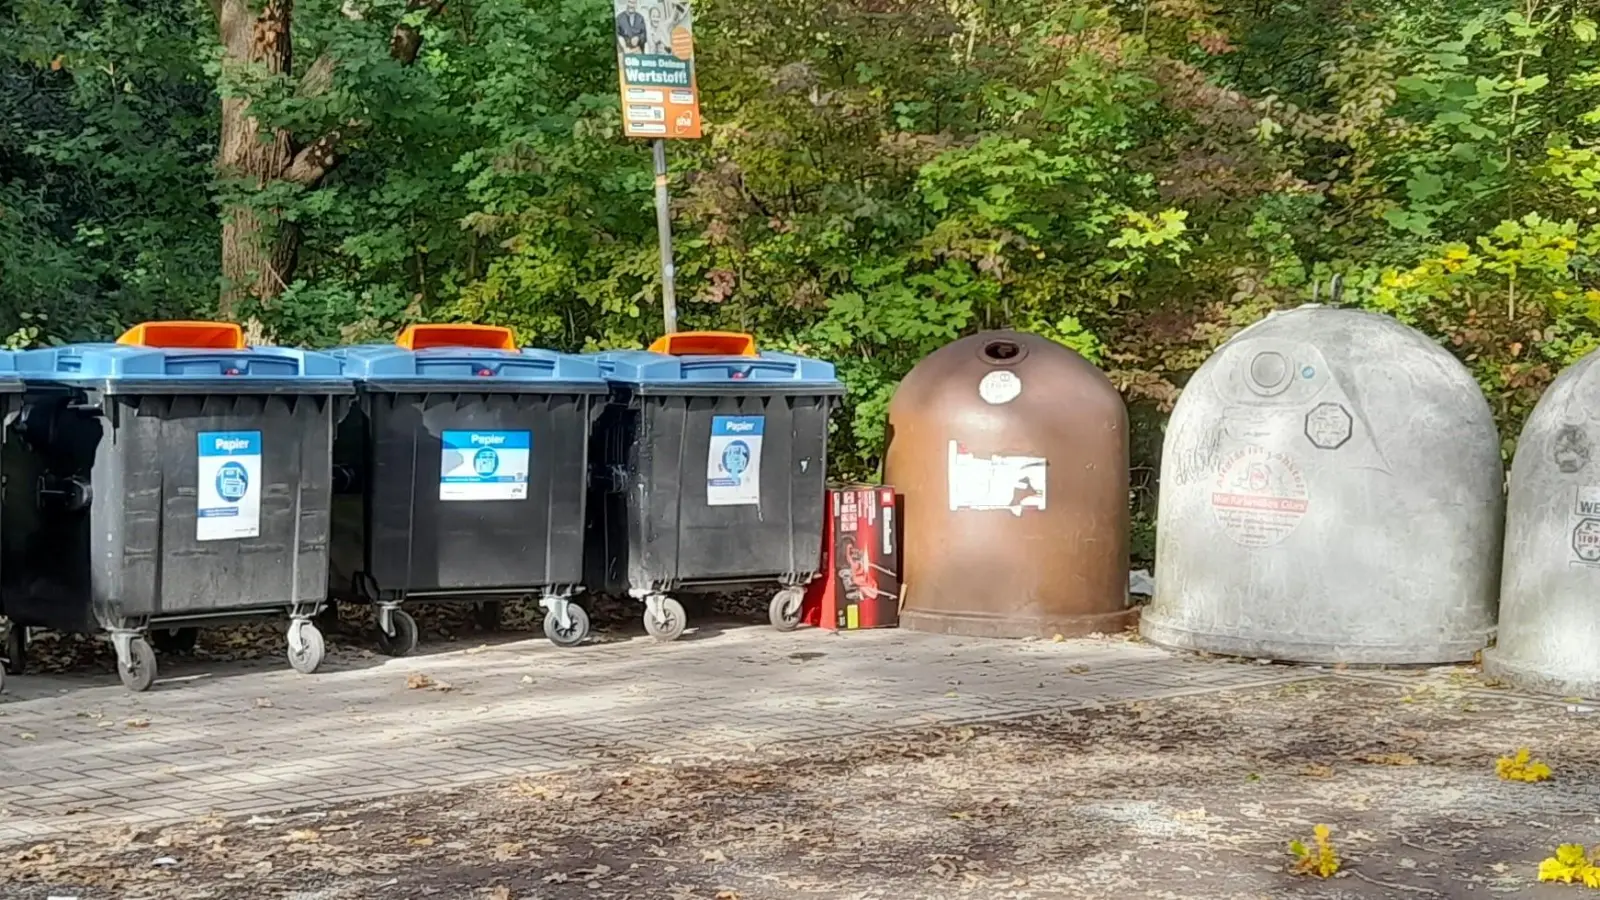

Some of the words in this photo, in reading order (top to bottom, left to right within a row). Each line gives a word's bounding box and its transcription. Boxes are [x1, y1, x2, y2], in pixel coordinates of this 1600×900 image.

[625, 57, 640, 67] Gib
[625, 69, 688, 84] Wertstoff!
[726, 420, 755, 432] Papier
[215, 438, 250, 454] Papier
[471, 433, 505, 446] Papier
